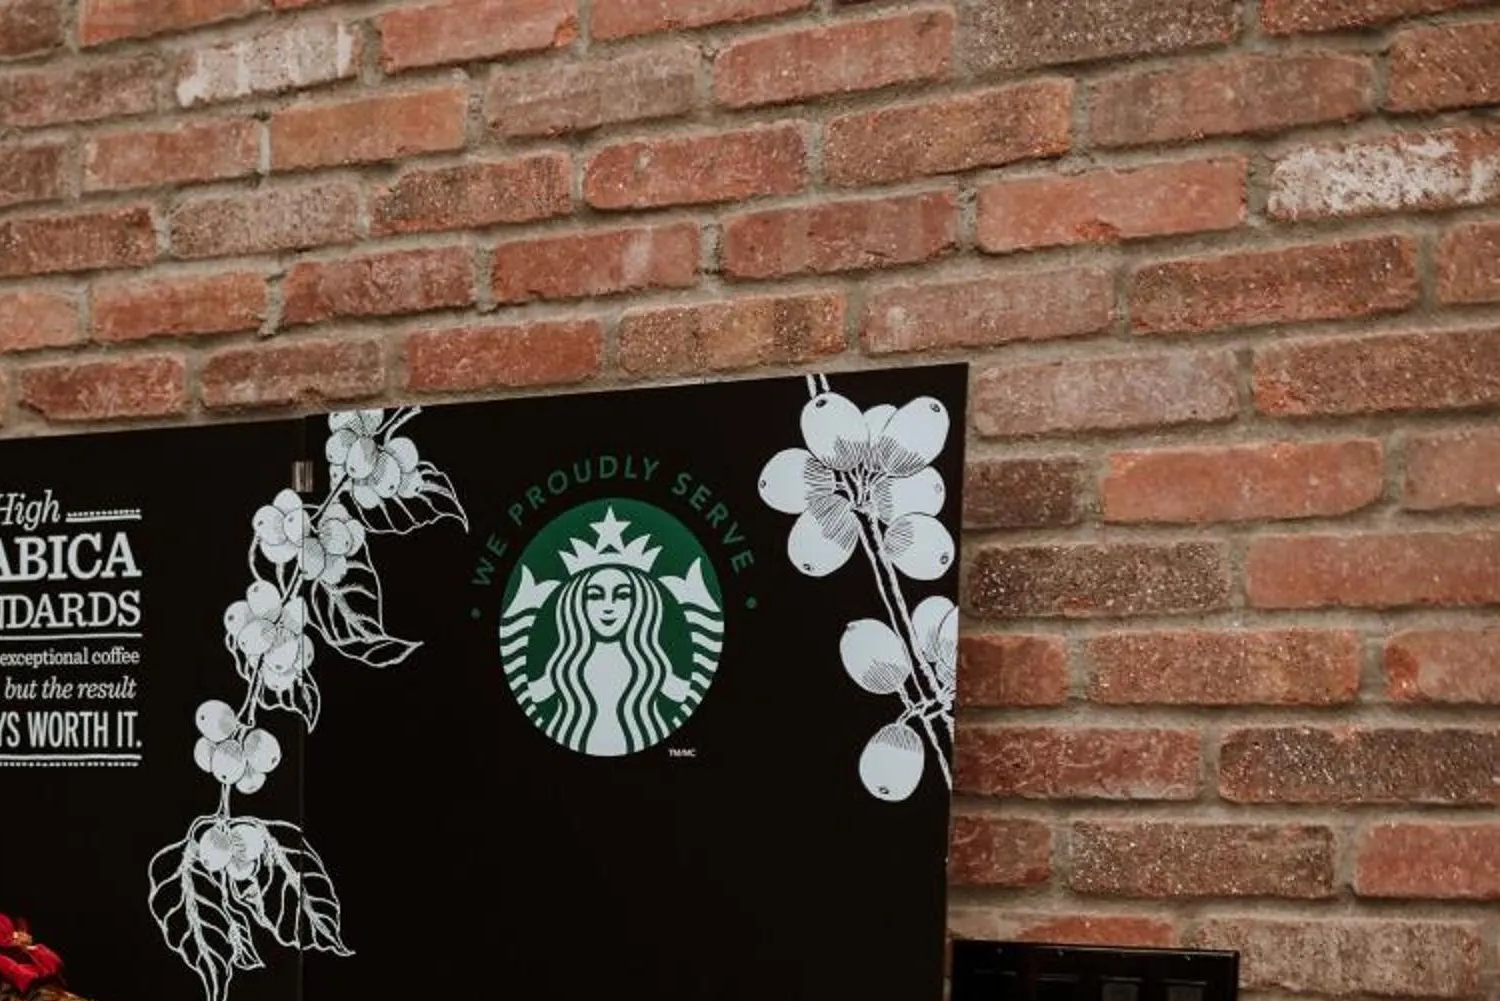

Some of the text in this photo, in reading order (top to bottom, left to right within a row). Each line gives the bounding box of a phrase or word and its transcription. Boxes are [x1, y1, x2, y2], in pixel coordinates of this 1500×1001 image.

[472, 456, 755, 586] WE PROUDLY SERVE
[0, 647, 89, 669] exceptional
[92, 646, 140, 665] coffee
[4, 677, 37, 700] but
[41, 676, 73, 699] the
[77, 675, 137, 699] result
[27, 711, 108, 748] WORTH
[117, 711, 142, 748] IT.
